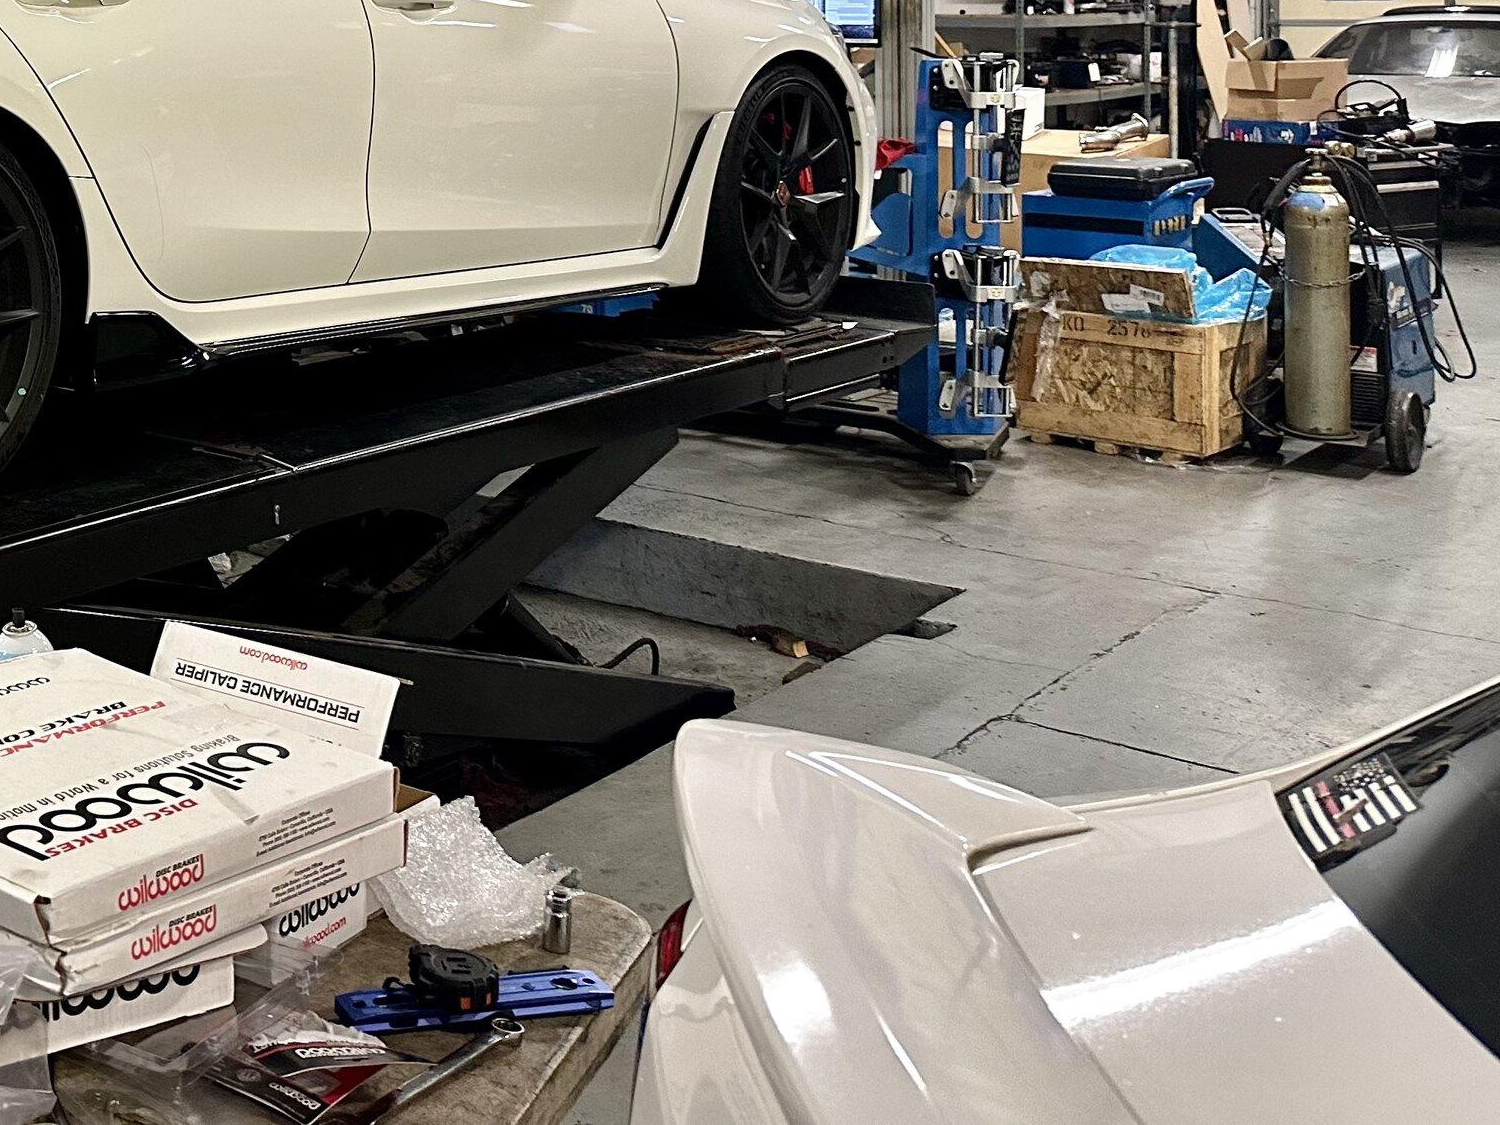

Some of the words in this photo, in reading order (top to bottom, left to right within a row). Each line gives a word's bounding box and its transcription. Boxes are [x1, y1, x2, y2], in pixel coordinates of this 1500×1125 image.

[239, 645, 308, 671] wilwood.com
[175, 662, 238, 689] CALIPER
[240, 680, 361, 723] PERFORMANCE
[42, 701, 127, 731] BRAKE
[191, 734, 241, 753] Braking
[133, 749, 193, 774] Solutions
[100, 777, 109, 785] a
[112, 771, 132, 782] for
[38, 796, 53, 806] in
[56, 784, 98, 803] World
[149, 798, 199, 821] DISC
[45, 816, 144, 857] BRAKES
[156, 867, 172, 877] DISC
[173, 855, 200, 871] BRAKES
[118, 854, 204, 911] wilwood
[169, 916, 185, 927] DISC
[186, 905, 213, 921] BRAKES
[131, 904, 217, 960] wilwood
[300, 916, 347, 951] ilwood.com
